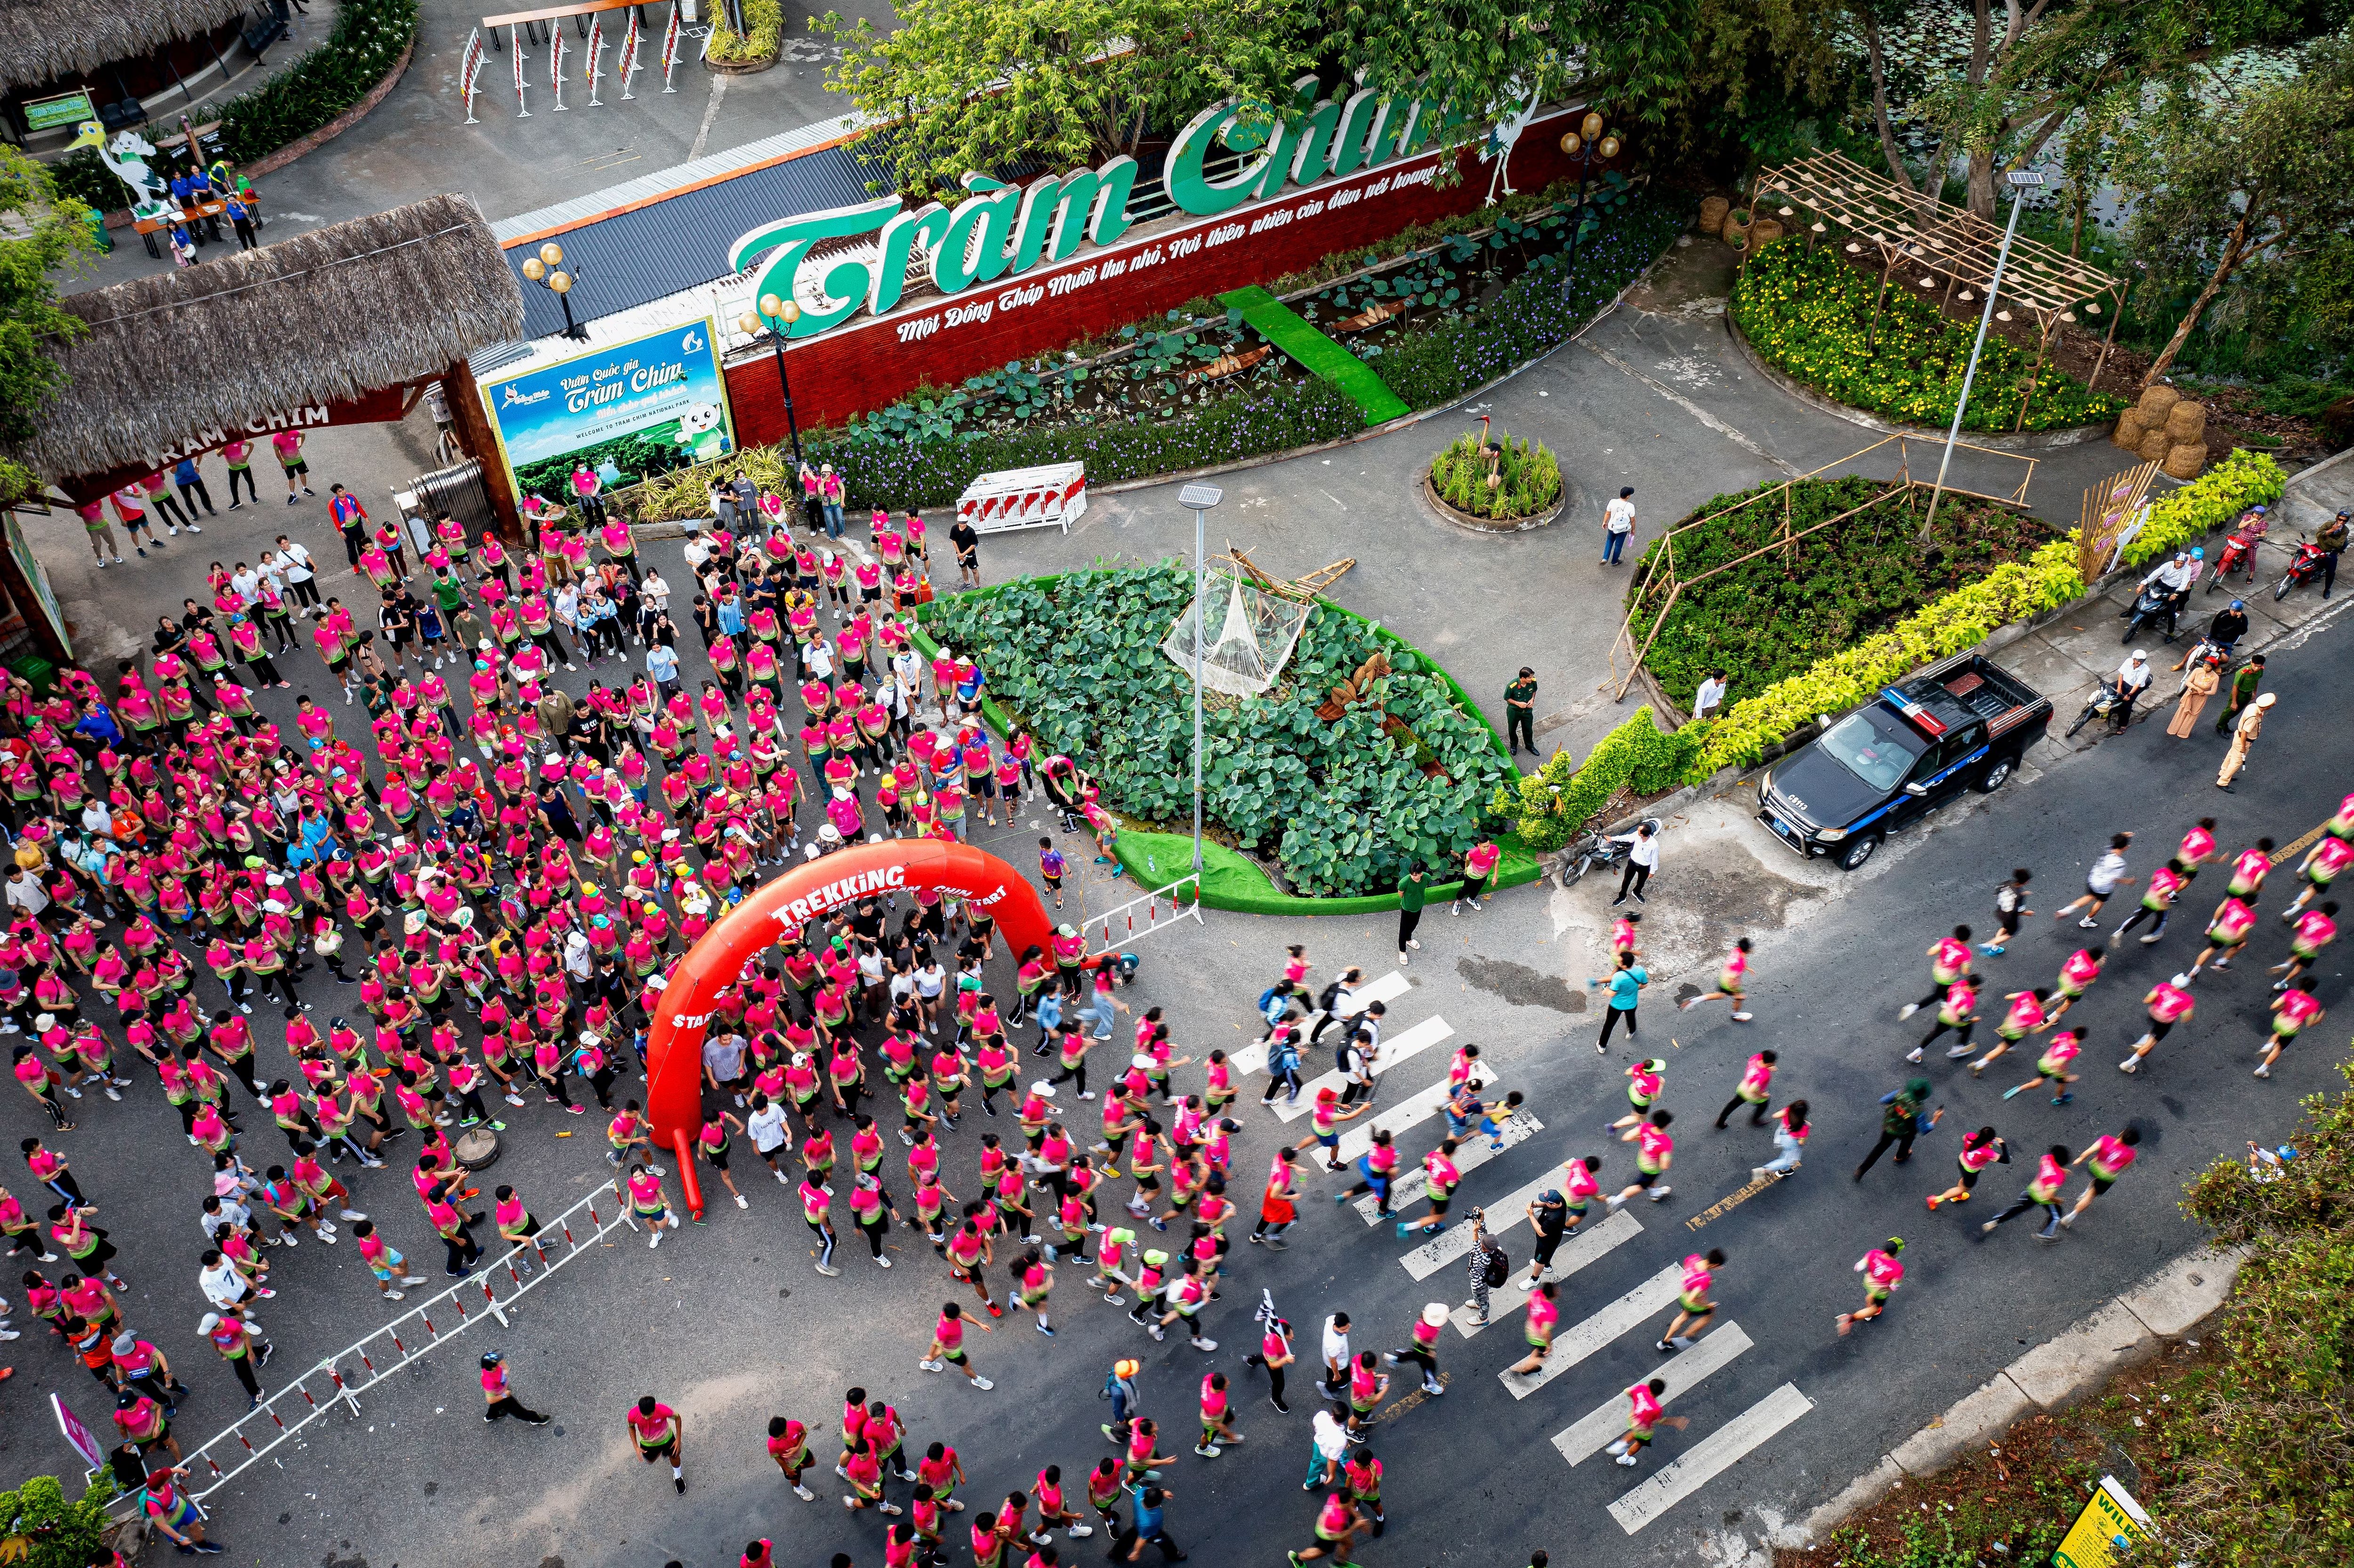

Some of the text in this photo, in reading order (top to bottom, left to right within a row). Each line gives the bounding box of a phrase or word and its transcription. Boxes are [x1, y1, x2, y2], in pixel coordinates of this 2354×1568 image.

[729, 154, 1138, 338] Tràm
[896, 314, 940, 343] Một
[944, 300, 994, 329] Đồng
[999, 283, 1044, 311] Tháp
[1048, 265, 1097, 297] Mười
[1100, 257, 1127, 281] thu
[1129, 244, 1165, 273] nhỏ,
[1169, 236, 1201, 260] Nơi
[1205, 221, 1246, 248] thiên
[1249, 208, 1294, 235] nhiên
[1296, 199, 1324, 220] còn
[1327, 189, 1362, 210] đậm
[1365, 176, 1387, 200] nét
[560, 358, 640, 391] Vườn Quốc gia
[564, 362, 685, 413] Tràm Chim
[246, 405, 329, 433] CHIM
[576, 427, 604, 439] WELCOME
[615, 418, 630, 427] TRAM
[633, 413, 647, 421] CHIM
[649, 405, 675, 416] NATIONAL
[676, 399, 690, 408] PARK
[1947, 767, 1957, 775] SÁT
[1788, 794, 1808, 811] CS113
[224, 1270, 234, 1287] 7
